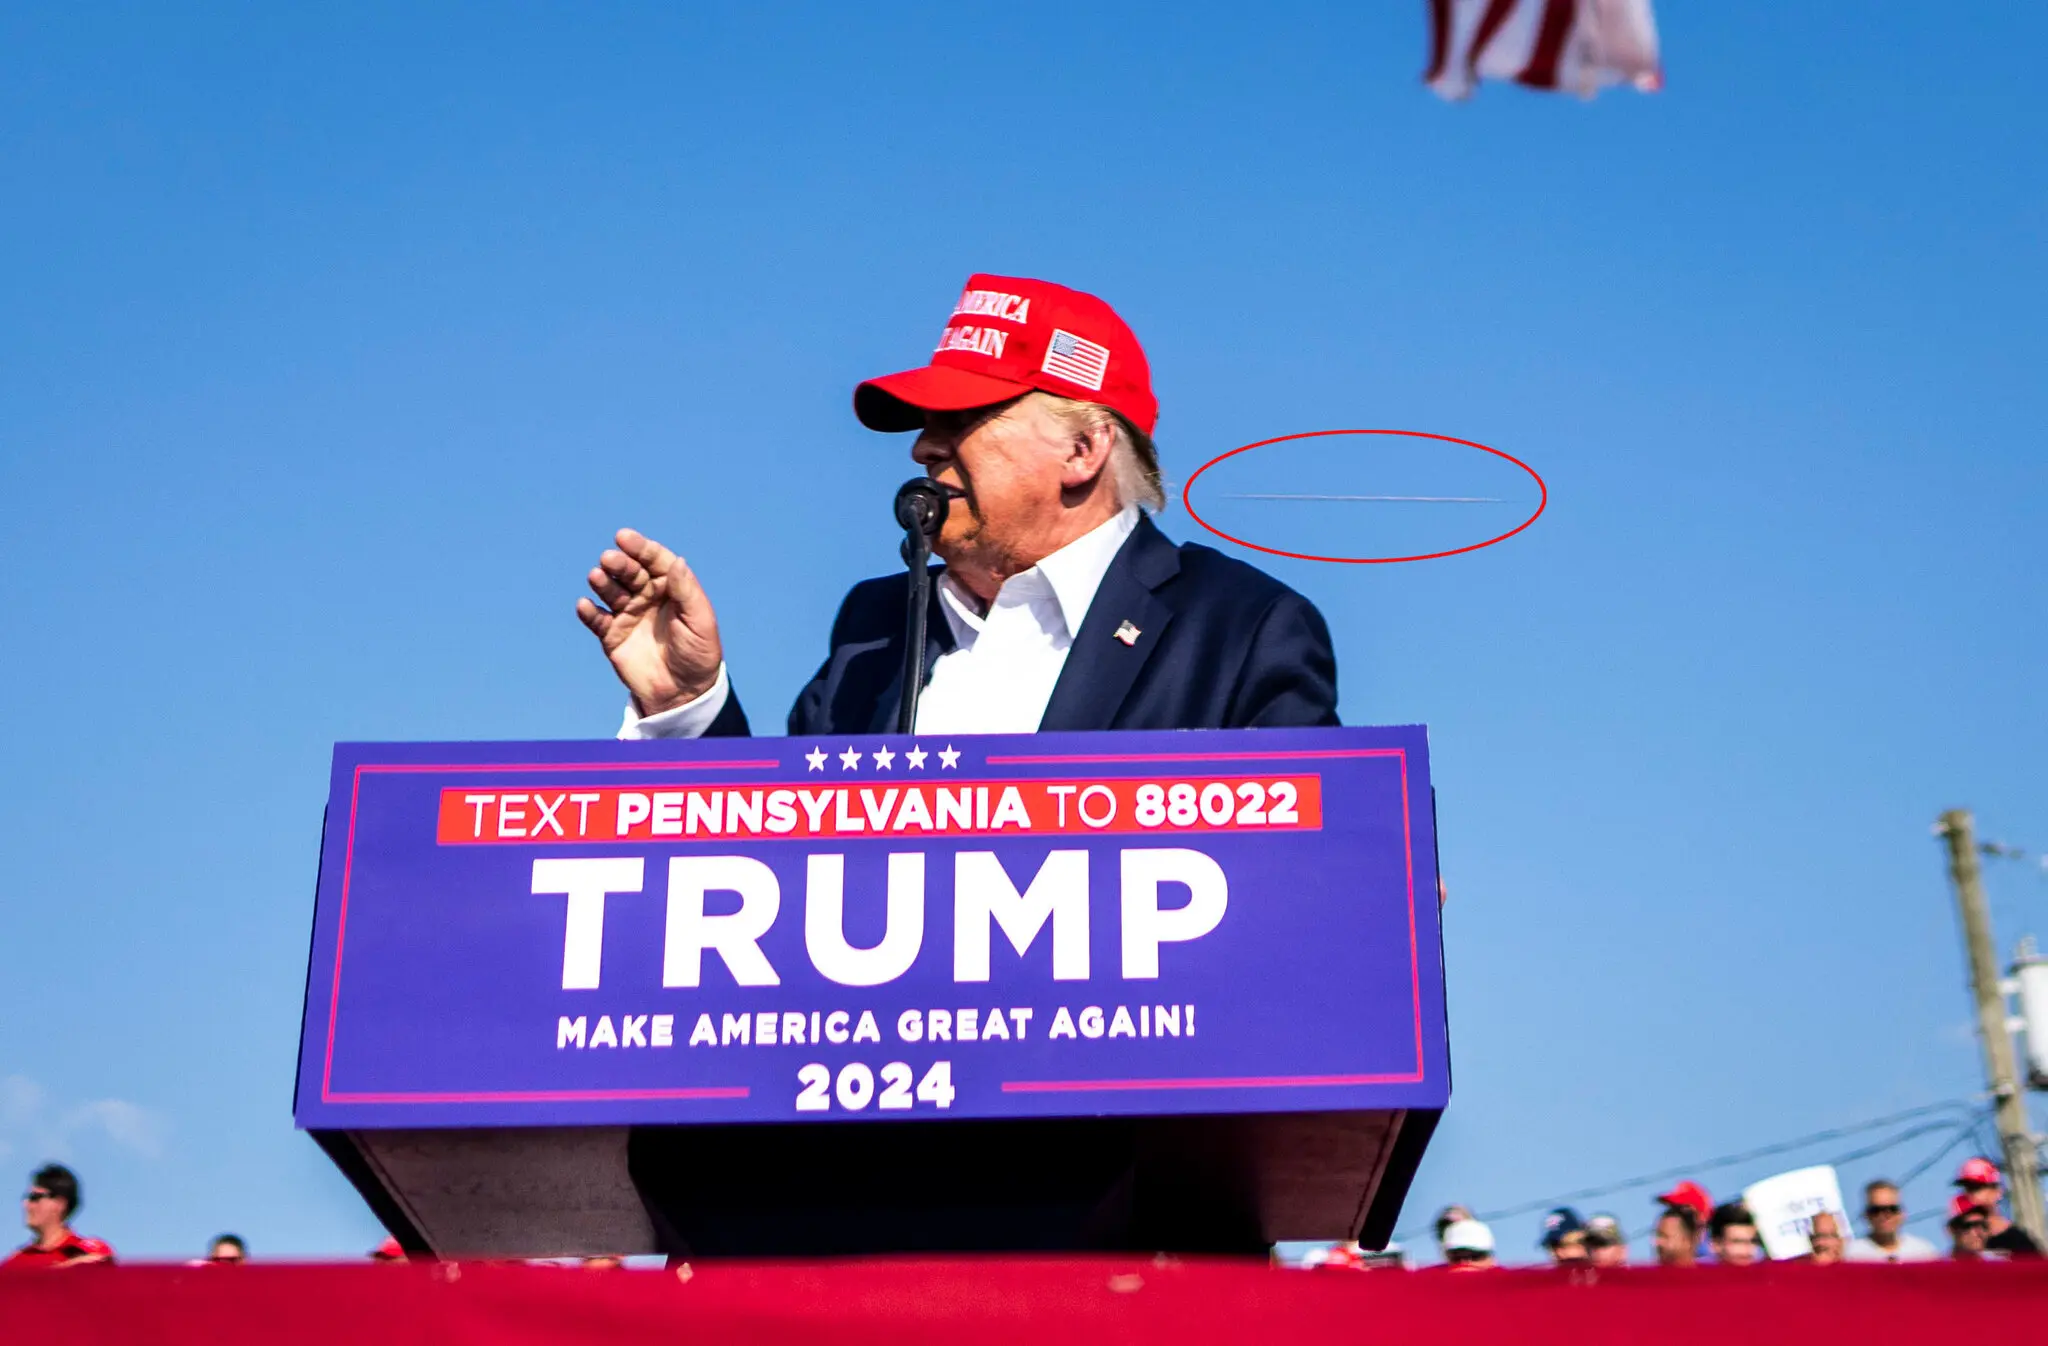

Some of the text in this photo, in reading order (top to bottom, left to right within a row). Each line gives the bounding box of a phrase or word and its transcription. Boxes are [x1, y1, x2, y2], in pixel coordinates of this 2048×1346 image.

[948, 325, 1009, 359] AGAIN
[464, 781, 1299, 838] TEXT PENNSYLVANIA TO 88022
[530, 848, 1230, 990] TRUMP
[556, 1004, 1195, 1049] MAKE AMERICA GREAT AGAIN!
[795, 1061, 956, 1111] 2024
